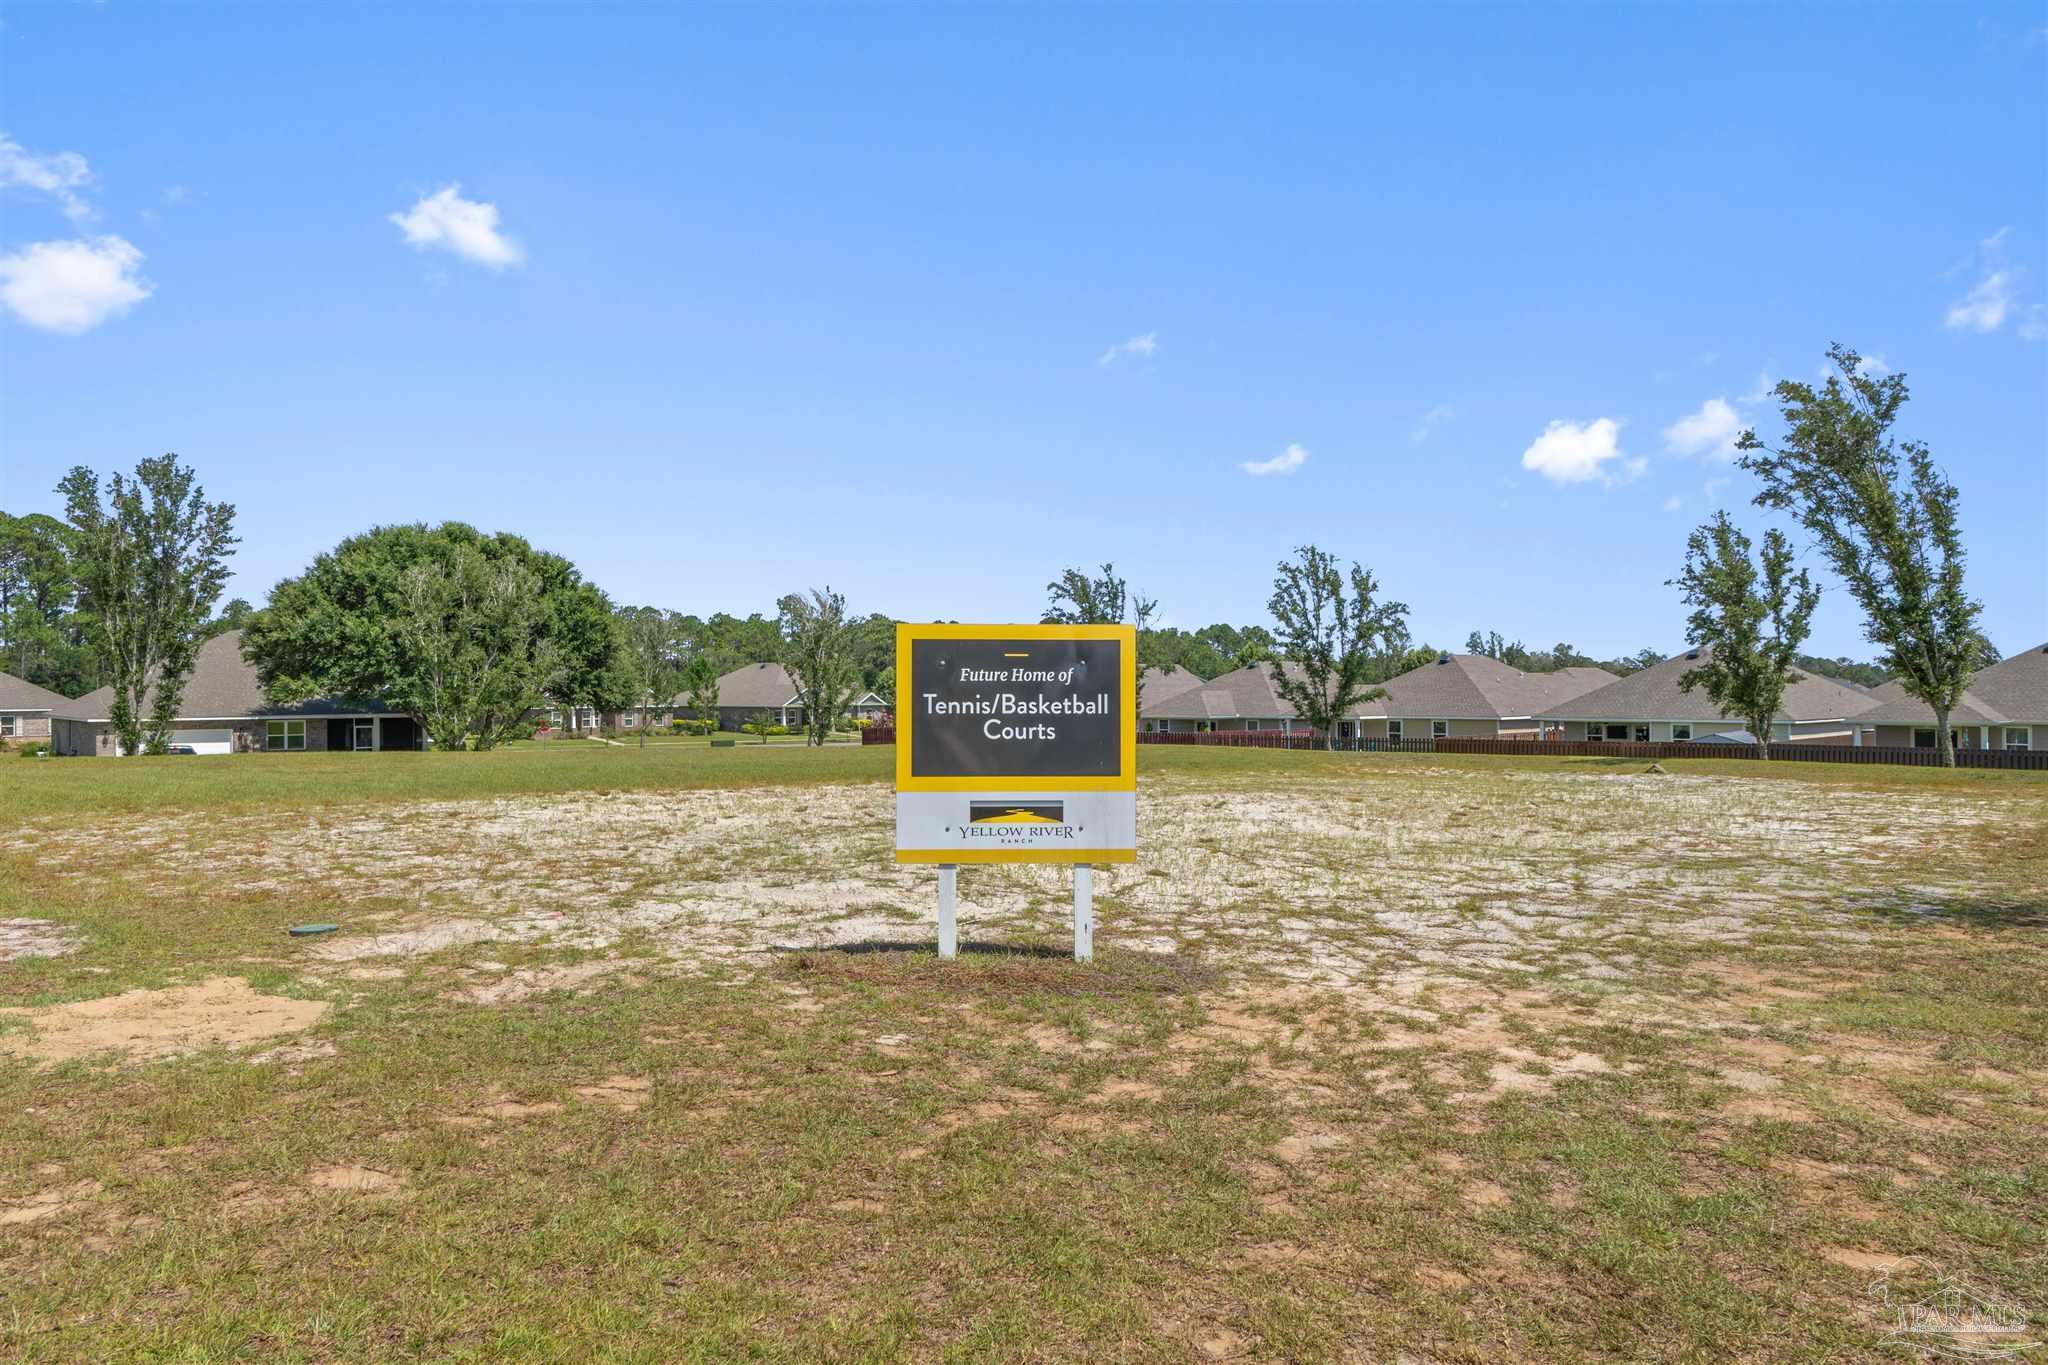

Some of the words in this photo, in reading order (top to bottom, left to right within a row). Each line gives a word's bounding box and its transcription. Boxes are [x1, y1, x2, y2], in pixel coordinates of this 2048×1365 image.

[960, 668, 1008, 682] Future
[1011, 668, 1054, 682] Home
[1058, 667, 1075, 686] of
[922, 693, 1109, 715] Tennis/Basketball
[983, 719, 1056, 740] Courts
[959, 826, 1023, 838] YELLOW
[1029, 826, 1074, 838] RIVER
